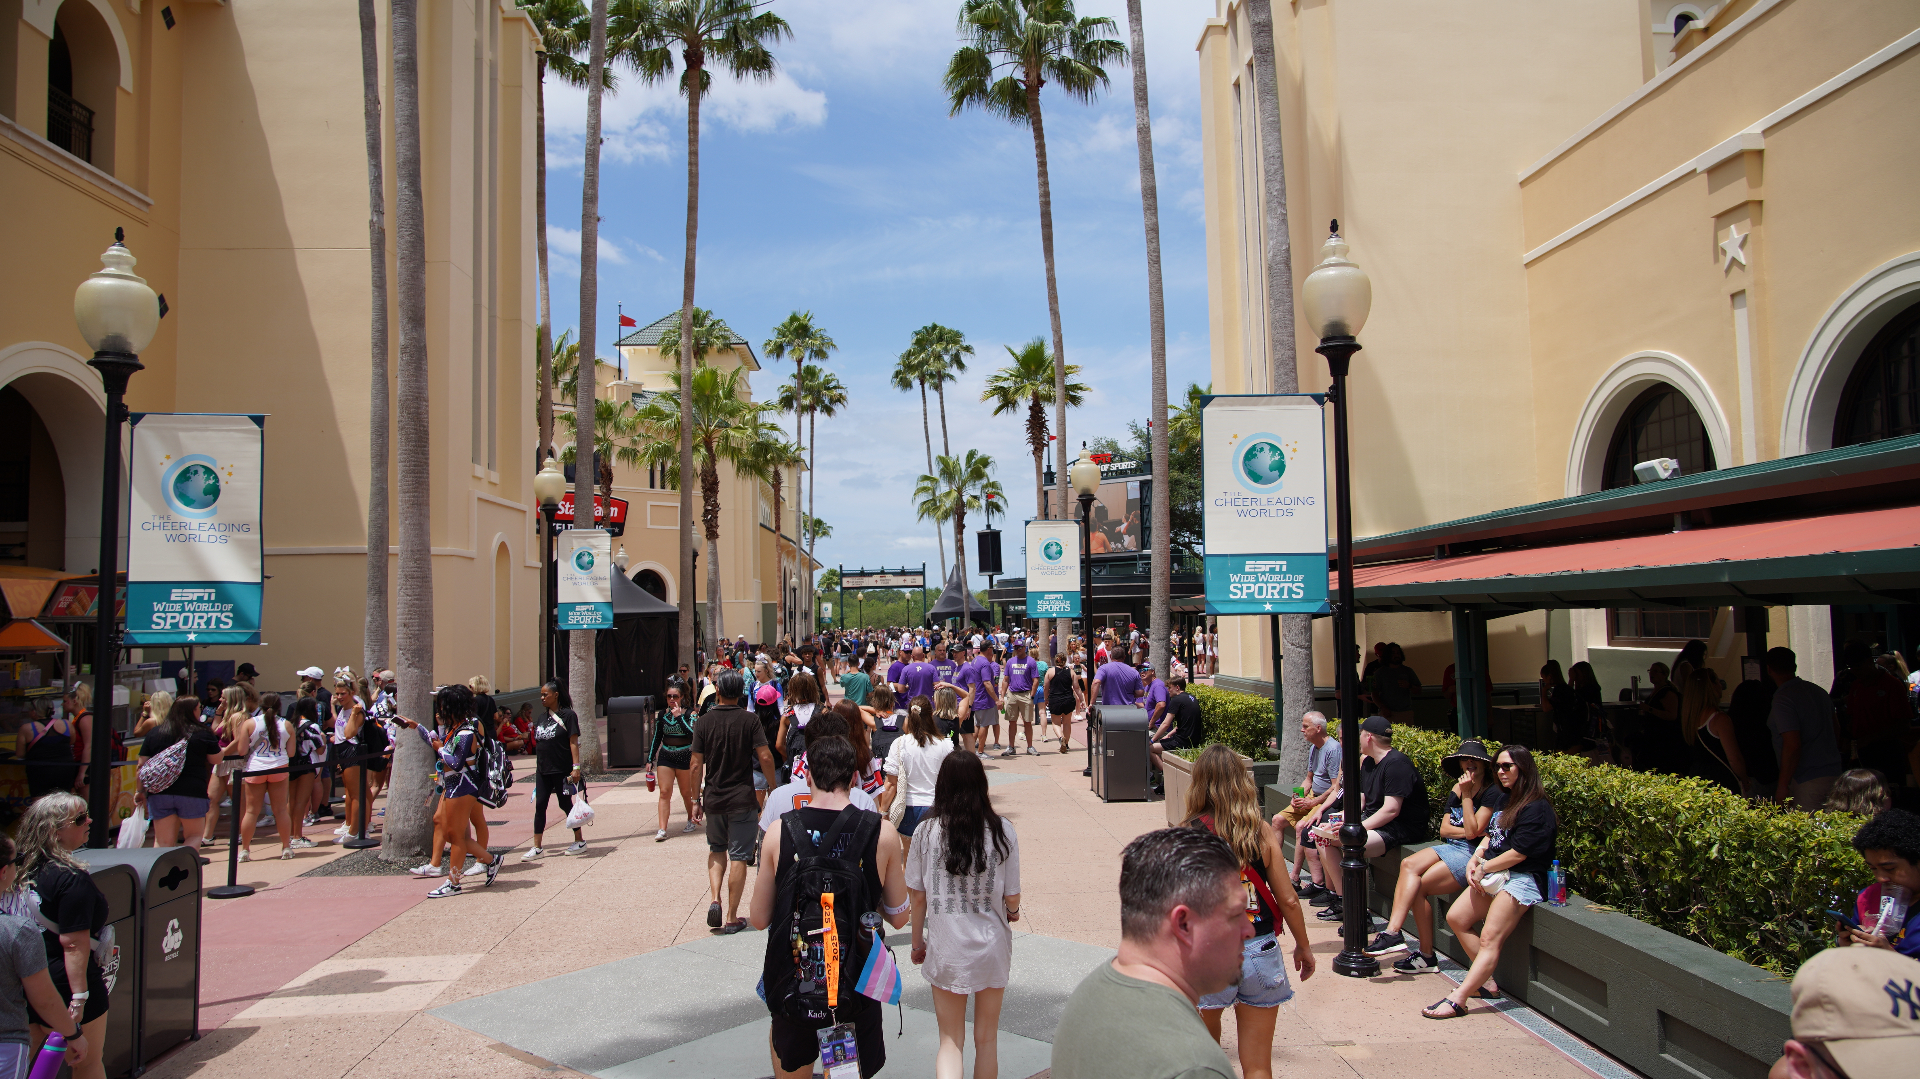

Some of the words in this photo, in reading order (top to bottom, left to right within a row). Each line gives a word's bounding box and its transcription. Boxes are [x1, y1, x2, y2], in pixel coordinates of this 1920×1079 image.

[1110, 460, 1137, 471] SPORTS
[1214, 496, 1315, 507] CHEERLEADING
[557, 500, 575, 515] Sta
[1236, 508, 1296, 518] WORLDS
[141, 521, 251, 533] CHEERLEADING
[164, 533, 231, 544] WORLDS
[1244, 560, 1287, 572] ESPN
[1229, 573, 1256, 583] WIDE
[1257, 573, 1293, 583] WORLD
[1293, 574, 1305, 582] OF
[170, 588, 216, 601] ESPN
[1228, 582, 1305, 599] SPORTS
[153, 602, 182, 612] WIDE
[183, 602, 221, 612] WORLD
[222, 603, 234, 611] OF
[1036, 604, 1071, 612] SPORTS
[151, 612, 234, 630] SPORTS
[568, 615, 602, 624] SPORTS
[256, 737, 282, 758] 24
[831, 936, 839, 961] 2025
[807, 1009, 828, 1019] Kady
